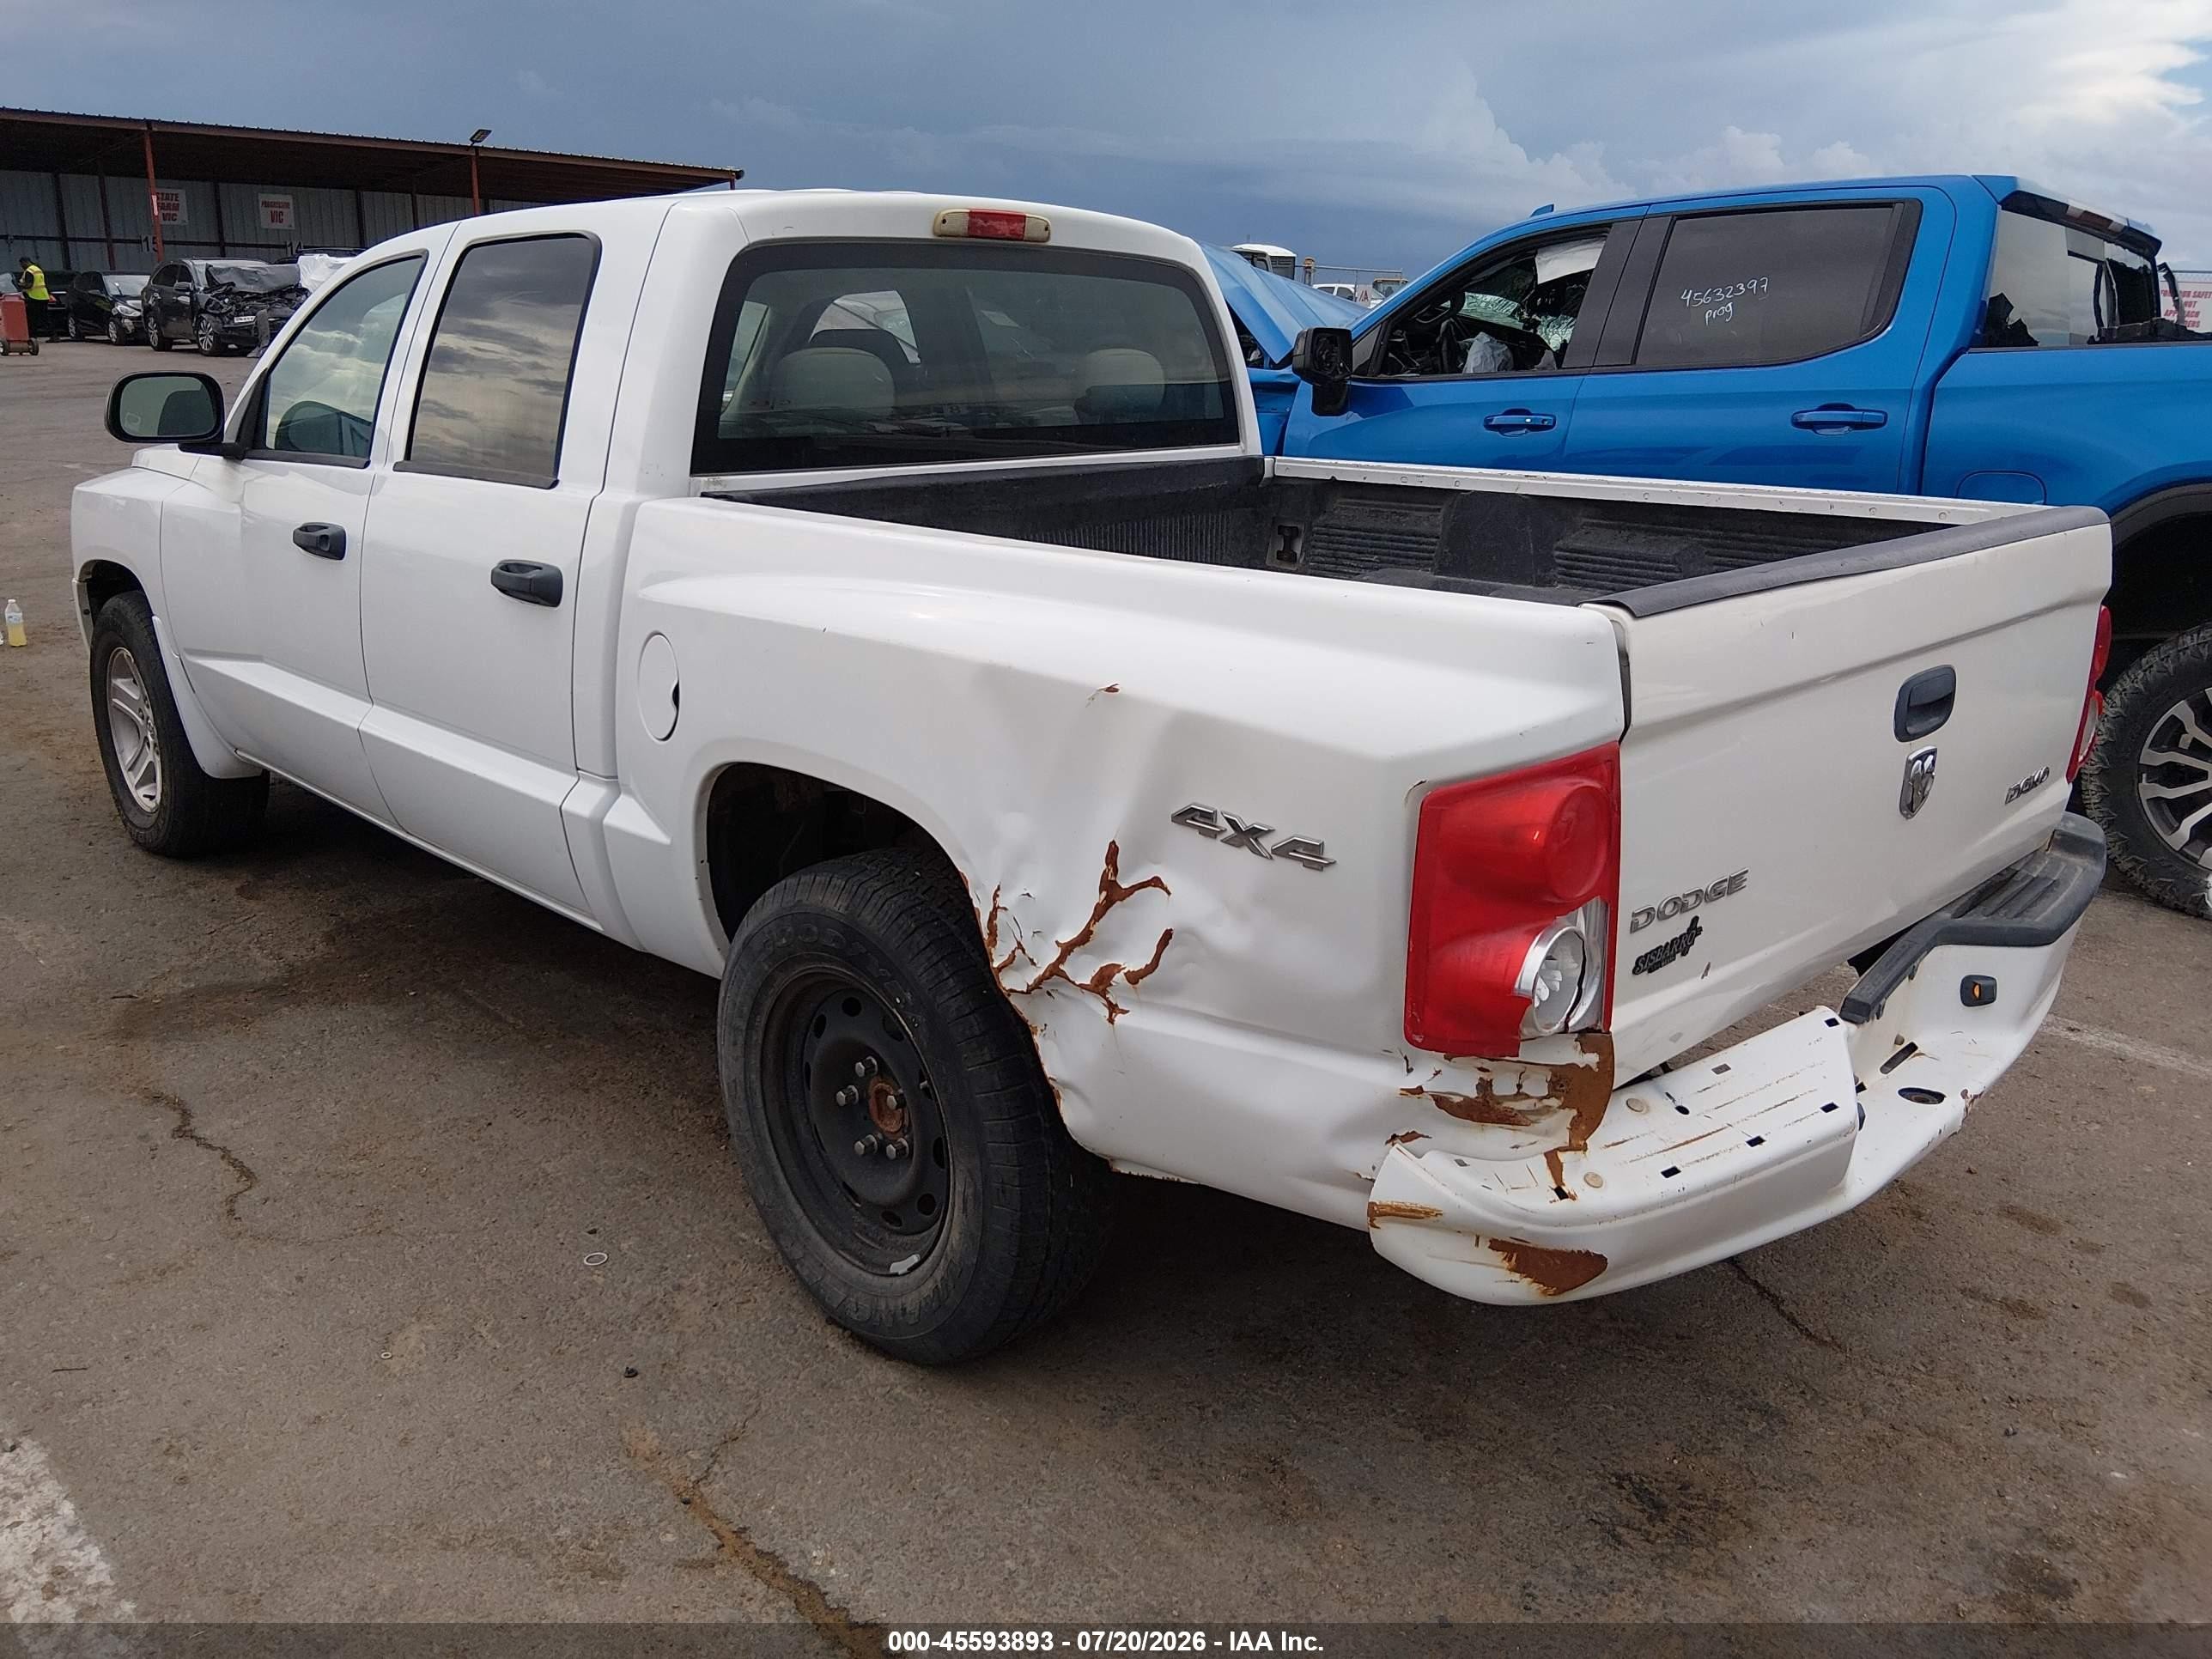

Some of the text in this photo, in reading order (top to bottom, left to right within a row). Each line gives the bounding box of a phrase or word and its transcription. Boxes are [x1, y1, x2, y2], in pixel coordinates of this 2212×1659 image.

[162, 212, 178, 222] VIC
[270, 210, 284, 223] VIC
[1680, 276, 1769, 307] 45632397
[1705, 301, 1734, 325] prog
[1630, 867, 1750, 934] DODGE
[1632, 927, 1698, 975] SISBARRO
